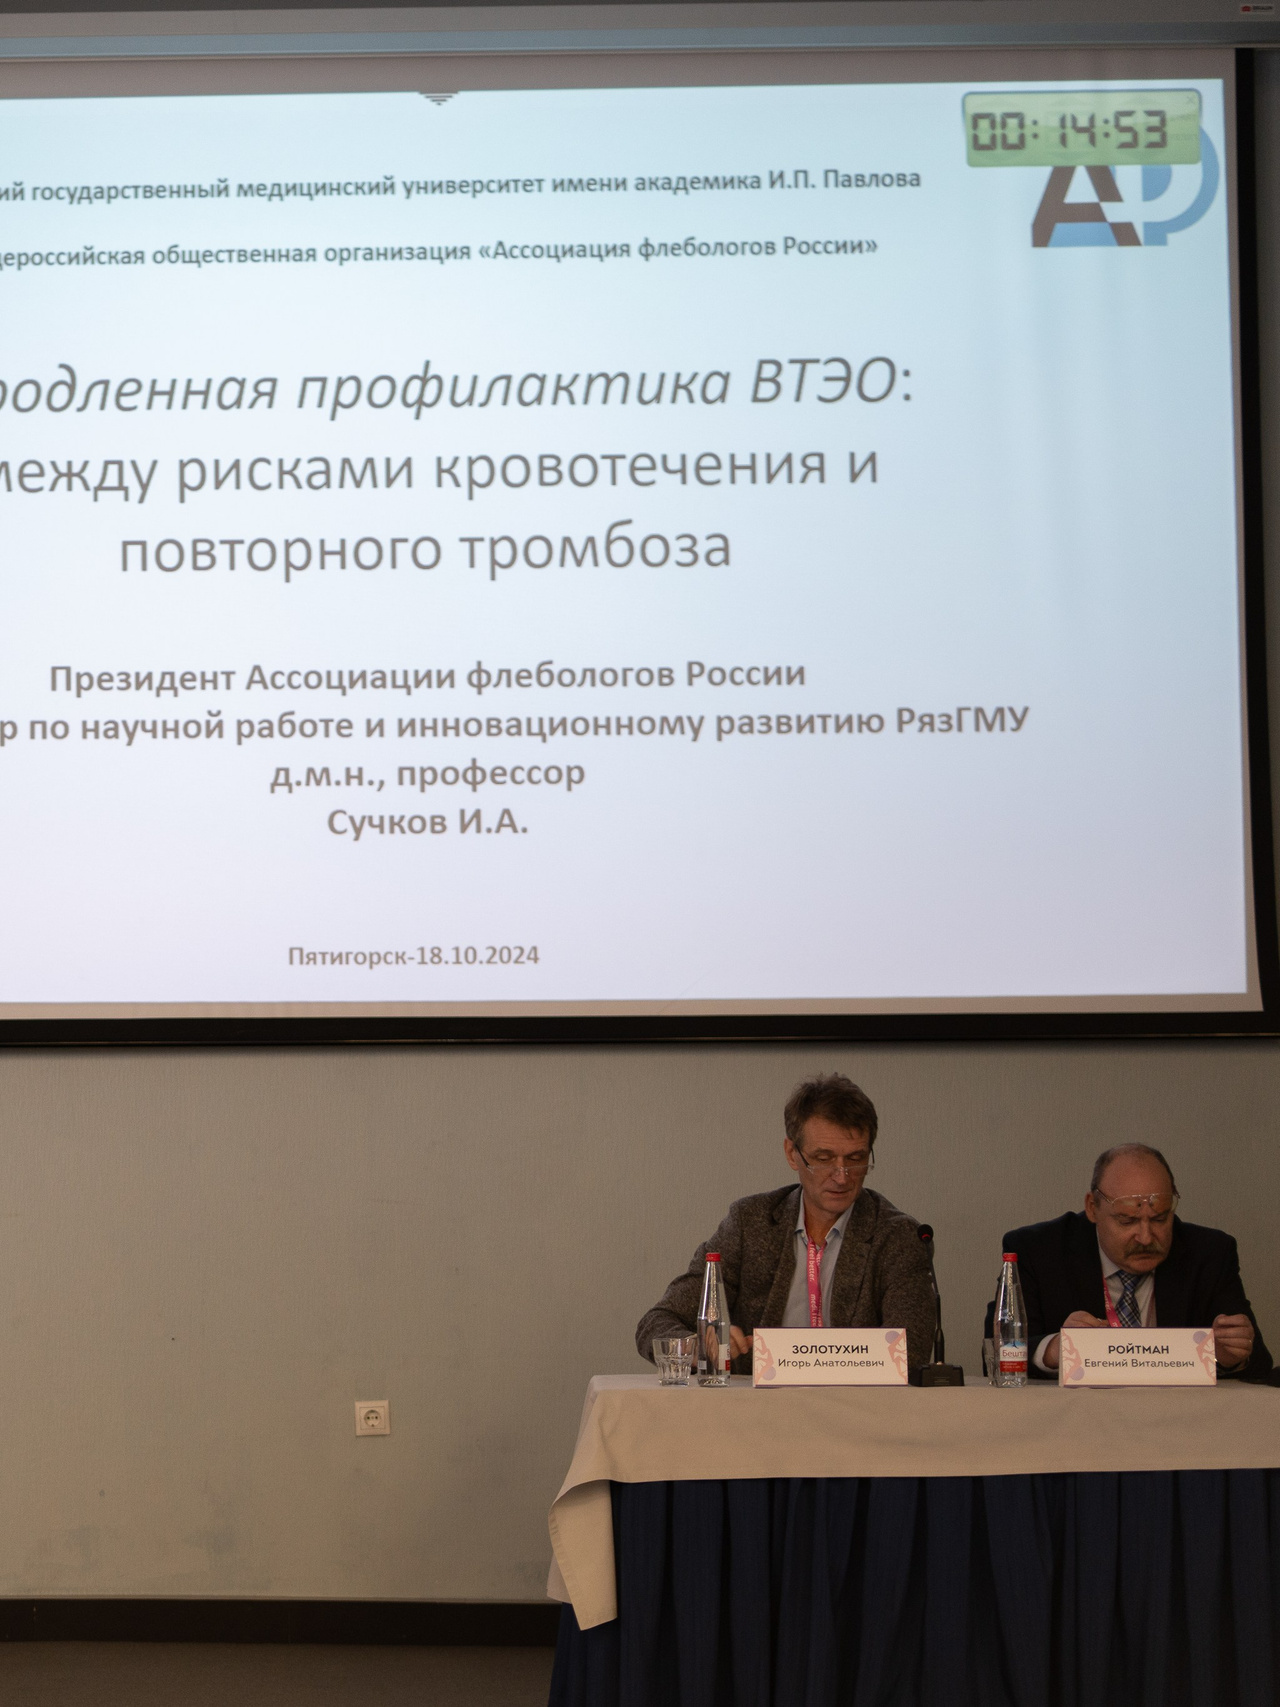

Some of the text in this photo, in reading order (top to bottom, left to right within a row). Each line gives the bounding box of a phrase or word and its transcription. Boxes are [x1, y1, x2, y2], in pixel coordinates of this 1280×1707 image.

[971, 109, 1168, 152] 00:14:53
[32, 177, 230, 205] государственный
[236, 175, 396, 202] медицинский
[401, 177, 545, 200] университет
[552, 177, 628, 193] имени
[634, 175, 762, 196] академика
[769, 170, 817, 190] И.П.
[823, 168, 922, 189] Павлова
[152, 244, 318, 270] общественная
[324, 244, 472, 267] организация
[478, 240, 632, 264] «Ассоциация
[638, 236, 778, 263] флебологов
[783, 236, 878, 256] России»
[297, 359, 731, 422] профилактика
[750, 356, 912, 405] ВТЭО:
[178, 456, 414, 504] рисками
[435, 451, 827, 501] кровотечения
[849, 451, 877, 484] и
[121, 518, 730, 584] повторного тромбоза
[50, 659, 806, 699] Президент Ассоциации флебологов России
[29, 719, 70, 740] по
[81, 709, 224, 747] научной
[236, 710, 354, 746] работе
[365, 718, 385, 738] и
[397, 715, 705, 744] инновационному
[716, 713, 886, 742] развитию
[896, 706, 1030, 734] РязГМУ
[270, 757, 586, 794] д.м.н., профессор
[327, 808, 529, 842] Сучков И.А.
[287, 945, 541, 970] Пятигорск-18.10.2024
[778, 1358, 885, 1369] Игорь Анатольевич
[792, 1344, 869, 1355] ЗОЛОТУХИН
[1084, 1358, 1195, 1368] Евгений Витальевич
[1108, 1342, 1170, 1355] РОЙТМАН
